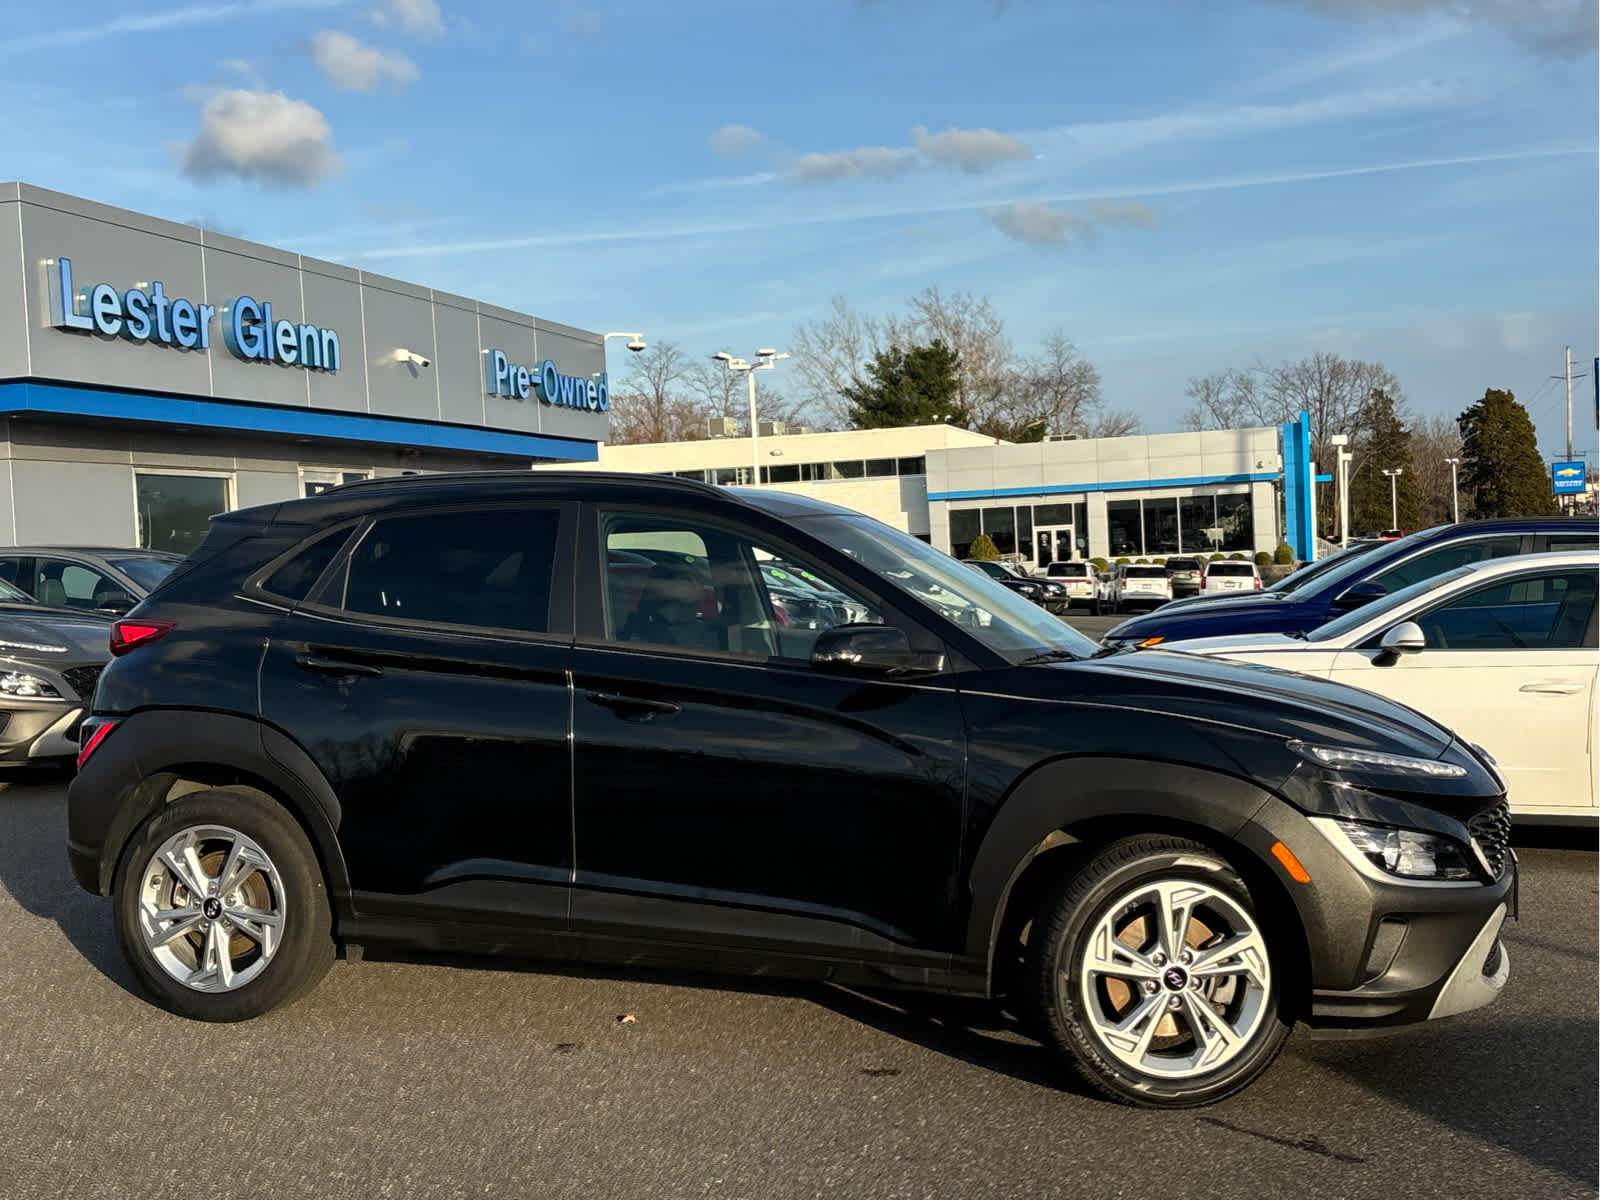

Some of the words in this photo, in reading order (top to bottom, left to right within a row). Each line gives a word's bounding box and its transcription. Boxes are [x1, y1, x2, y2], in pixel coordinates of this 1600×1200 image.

[56, 256, 215, 349] Lester
[229, 295, 341, 371] Glenn
[491, 349, 609, 412] Pre-Owned
